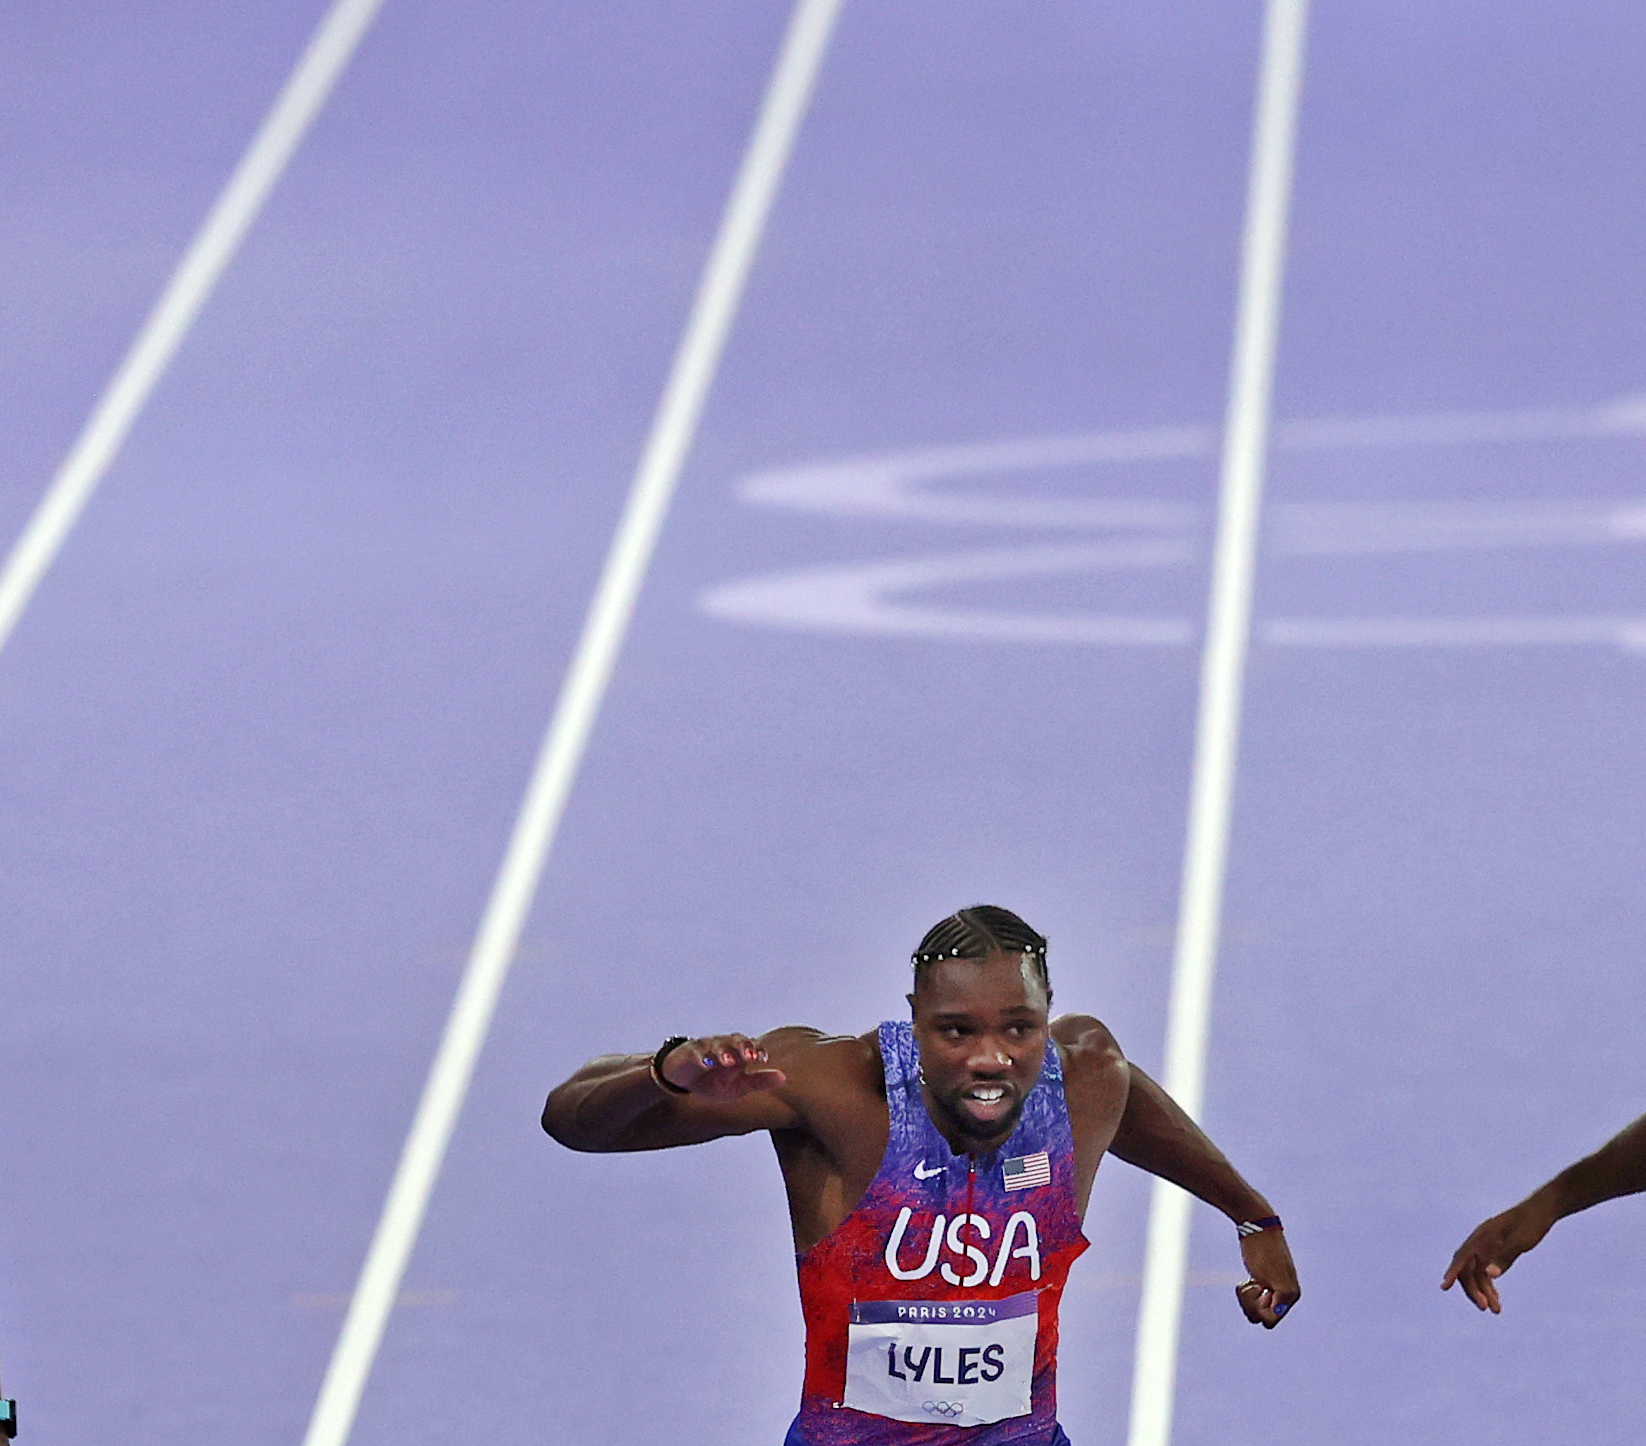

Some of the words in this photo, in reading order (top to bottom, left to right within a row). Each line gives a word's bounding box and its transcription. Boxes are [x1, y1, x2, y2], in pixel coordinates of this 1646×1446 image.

[885, 1206, 1041, 1288] USA
[897, 1306, 947, 1318] PARIS
[952, 1306, 996, 1319] 2024
[888, 1343, 1004, 1385] LYLES
